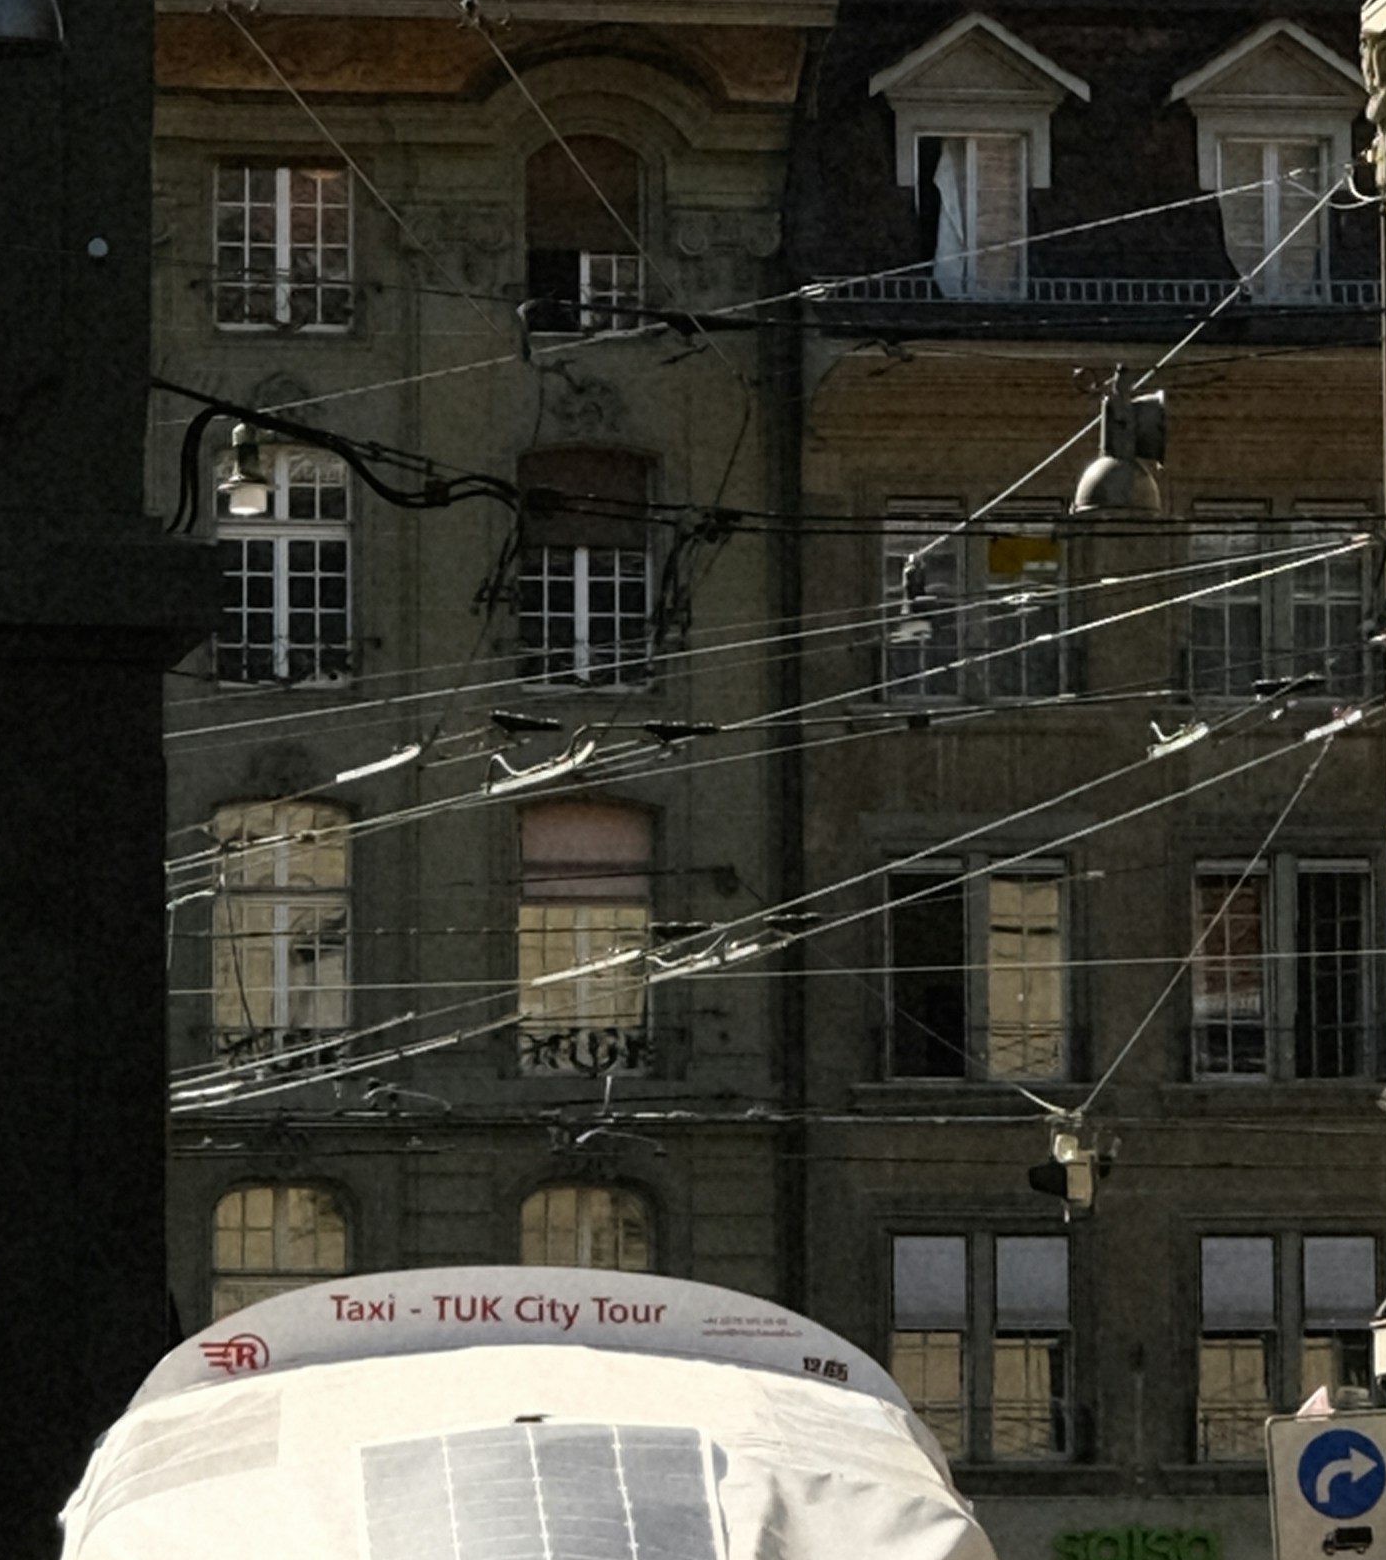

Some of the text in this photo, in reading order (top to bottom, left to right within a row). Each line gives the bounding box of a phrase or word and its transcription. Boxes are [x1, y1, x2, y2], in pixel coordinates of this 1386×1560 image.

[329, 1293, 396, 1322] Taxi
[432, 1294, 503, 1323] TUK
[514, 1295, 581, 1331] City
[589, 1296, 668, 1324] Tour
